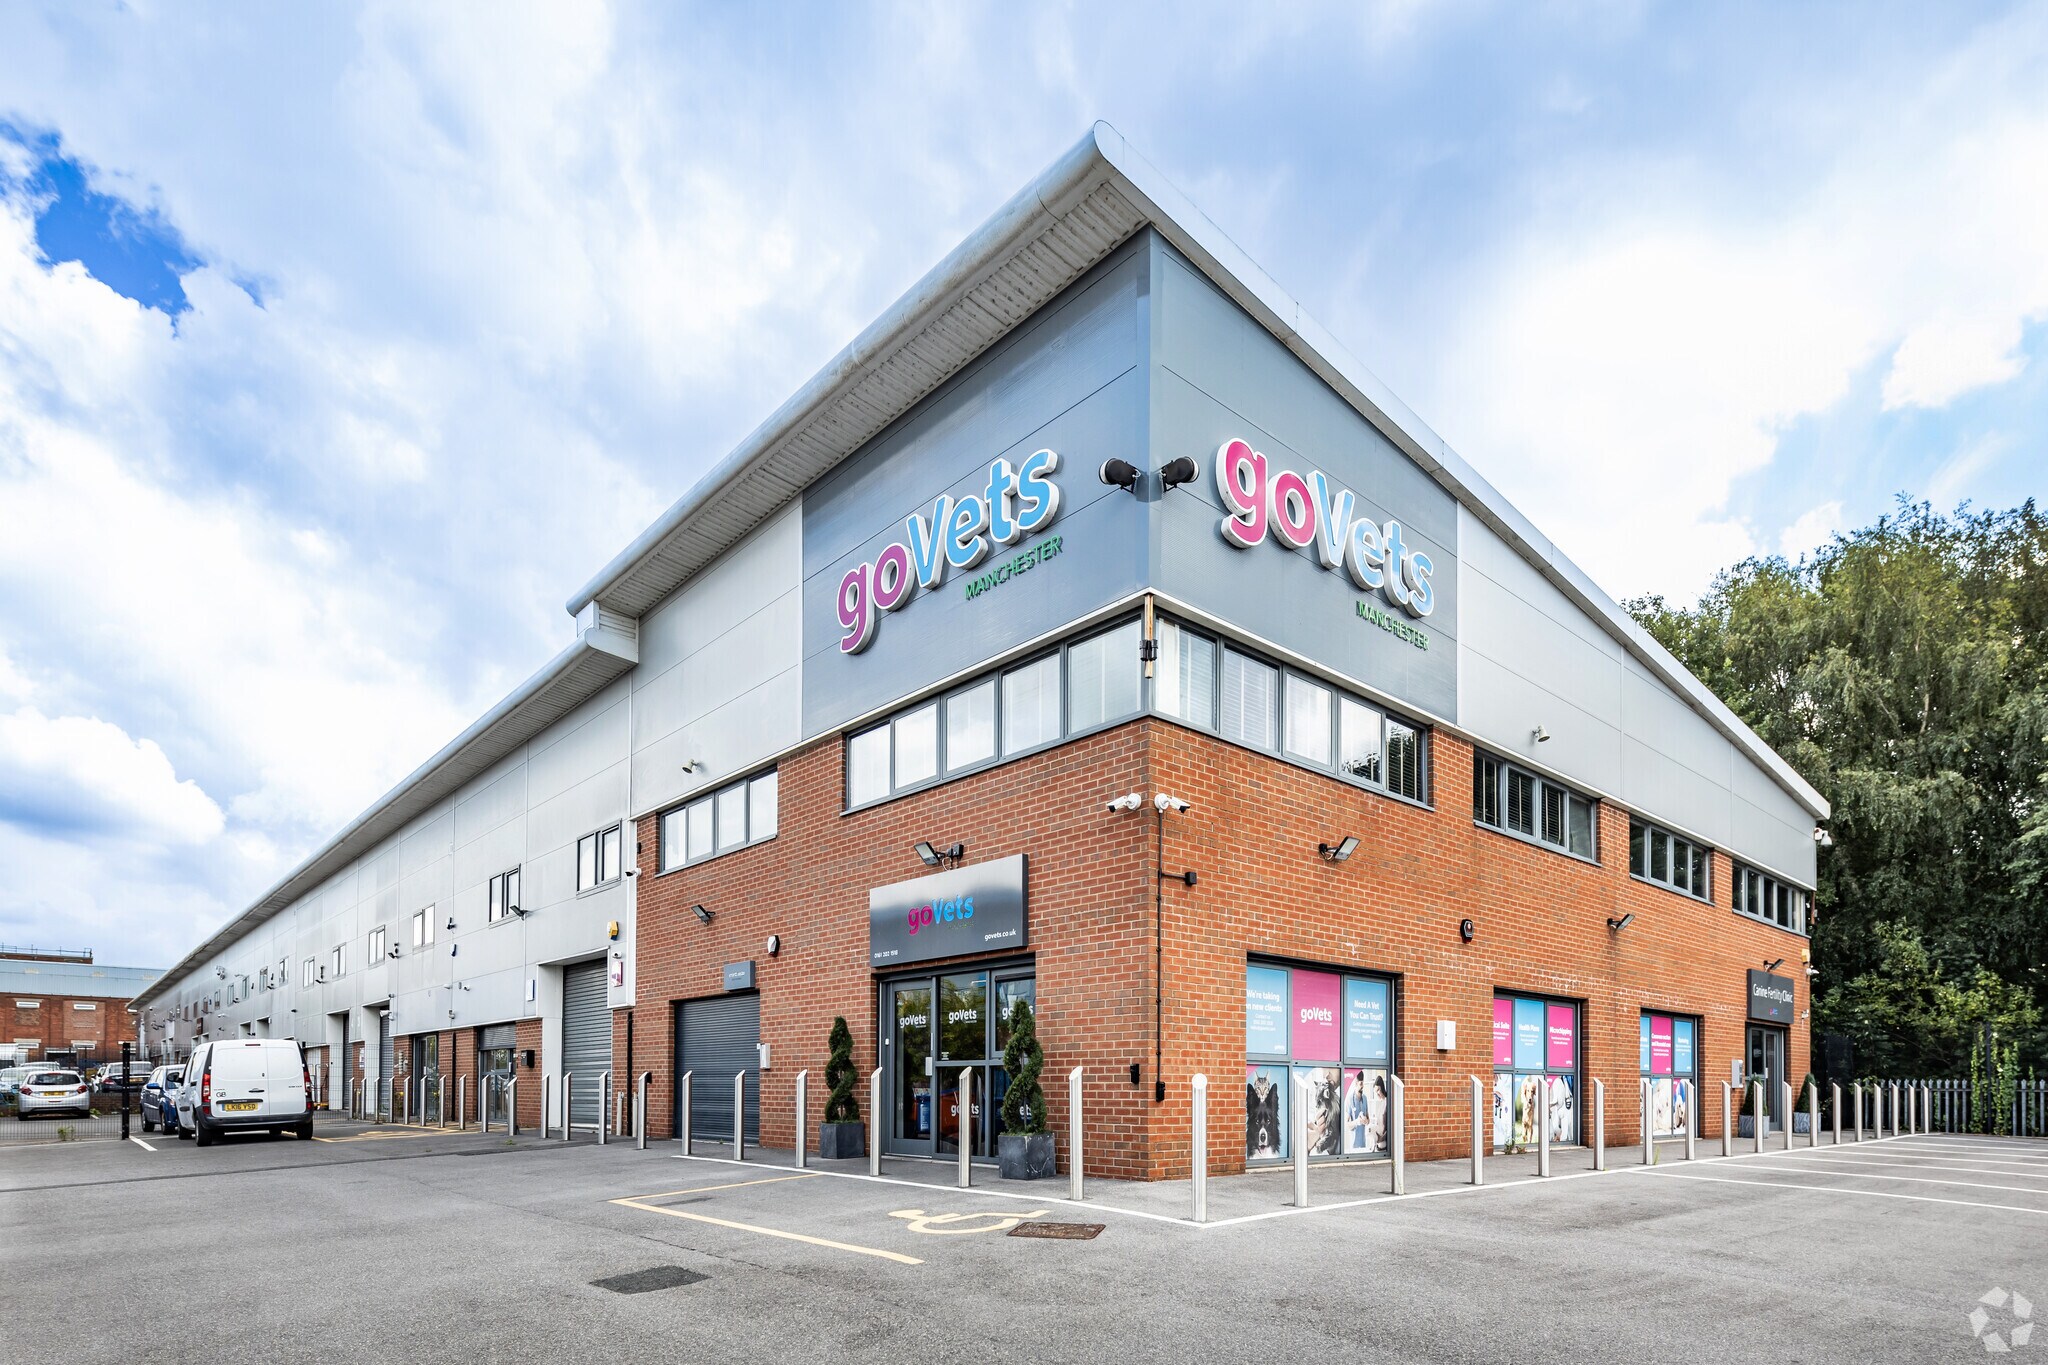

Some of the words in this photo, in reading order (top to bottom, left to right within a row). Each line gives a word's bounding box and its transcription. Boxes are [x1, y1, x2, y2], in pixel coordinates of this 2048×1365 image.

[1216, 438, 1434, 618] goVets
[837, 448, 1059, 654] goVets
[965, 535, 1063, 600] MANCHESTER
[1356, 601, 1430, 650] MANCHESTER
[908, 895, 974, 935] goVets
[1263, 991, 1280, 1003] taking
[1753, 983, 1767, 998] Canine
[1767, 986, 1783, 1004] Fertility
[1264, 1003, 1283, 1012] clients
[1354, 1000, 1367, 1008] Need
[899, 1014, 926, 1029] goVets
[948, 1009, 977, 1024] goVets
[1301, 1007, 1332, 1023] goVets
[1350, 1010, 1359, 1019] You
[1360, 1012, 1369, 1020] Can
[1369, 1012, 1384, 1021] Trust?
